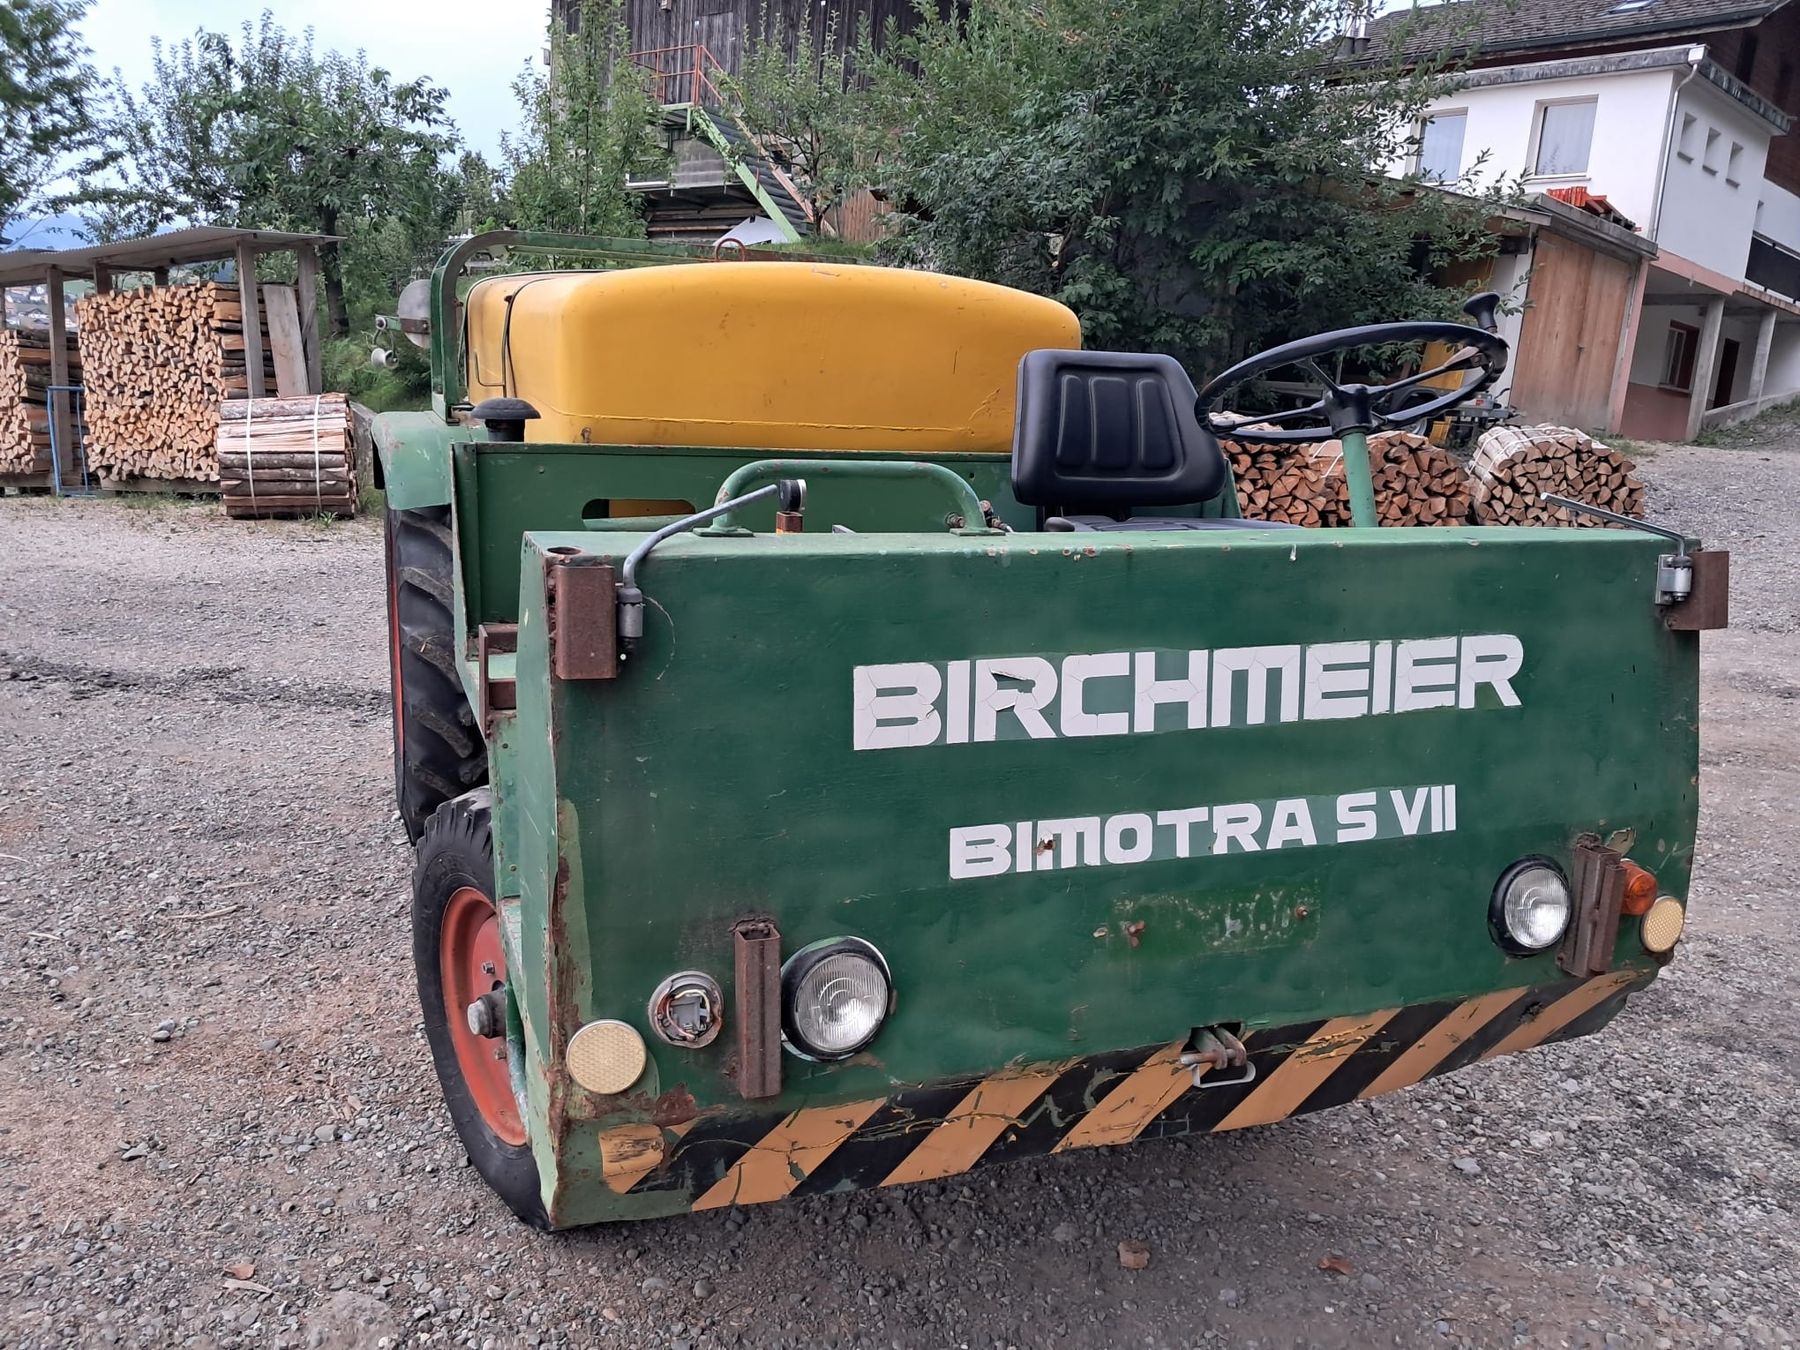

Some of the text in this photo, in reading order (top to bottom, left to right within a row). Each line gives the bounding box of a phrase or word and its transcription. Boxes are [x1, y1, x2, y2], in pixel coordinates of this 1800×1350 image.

[853, 634, 1523, 751] BIRCHMEIER
[949, 784, 1456, 879] BIMOTRA S VII
